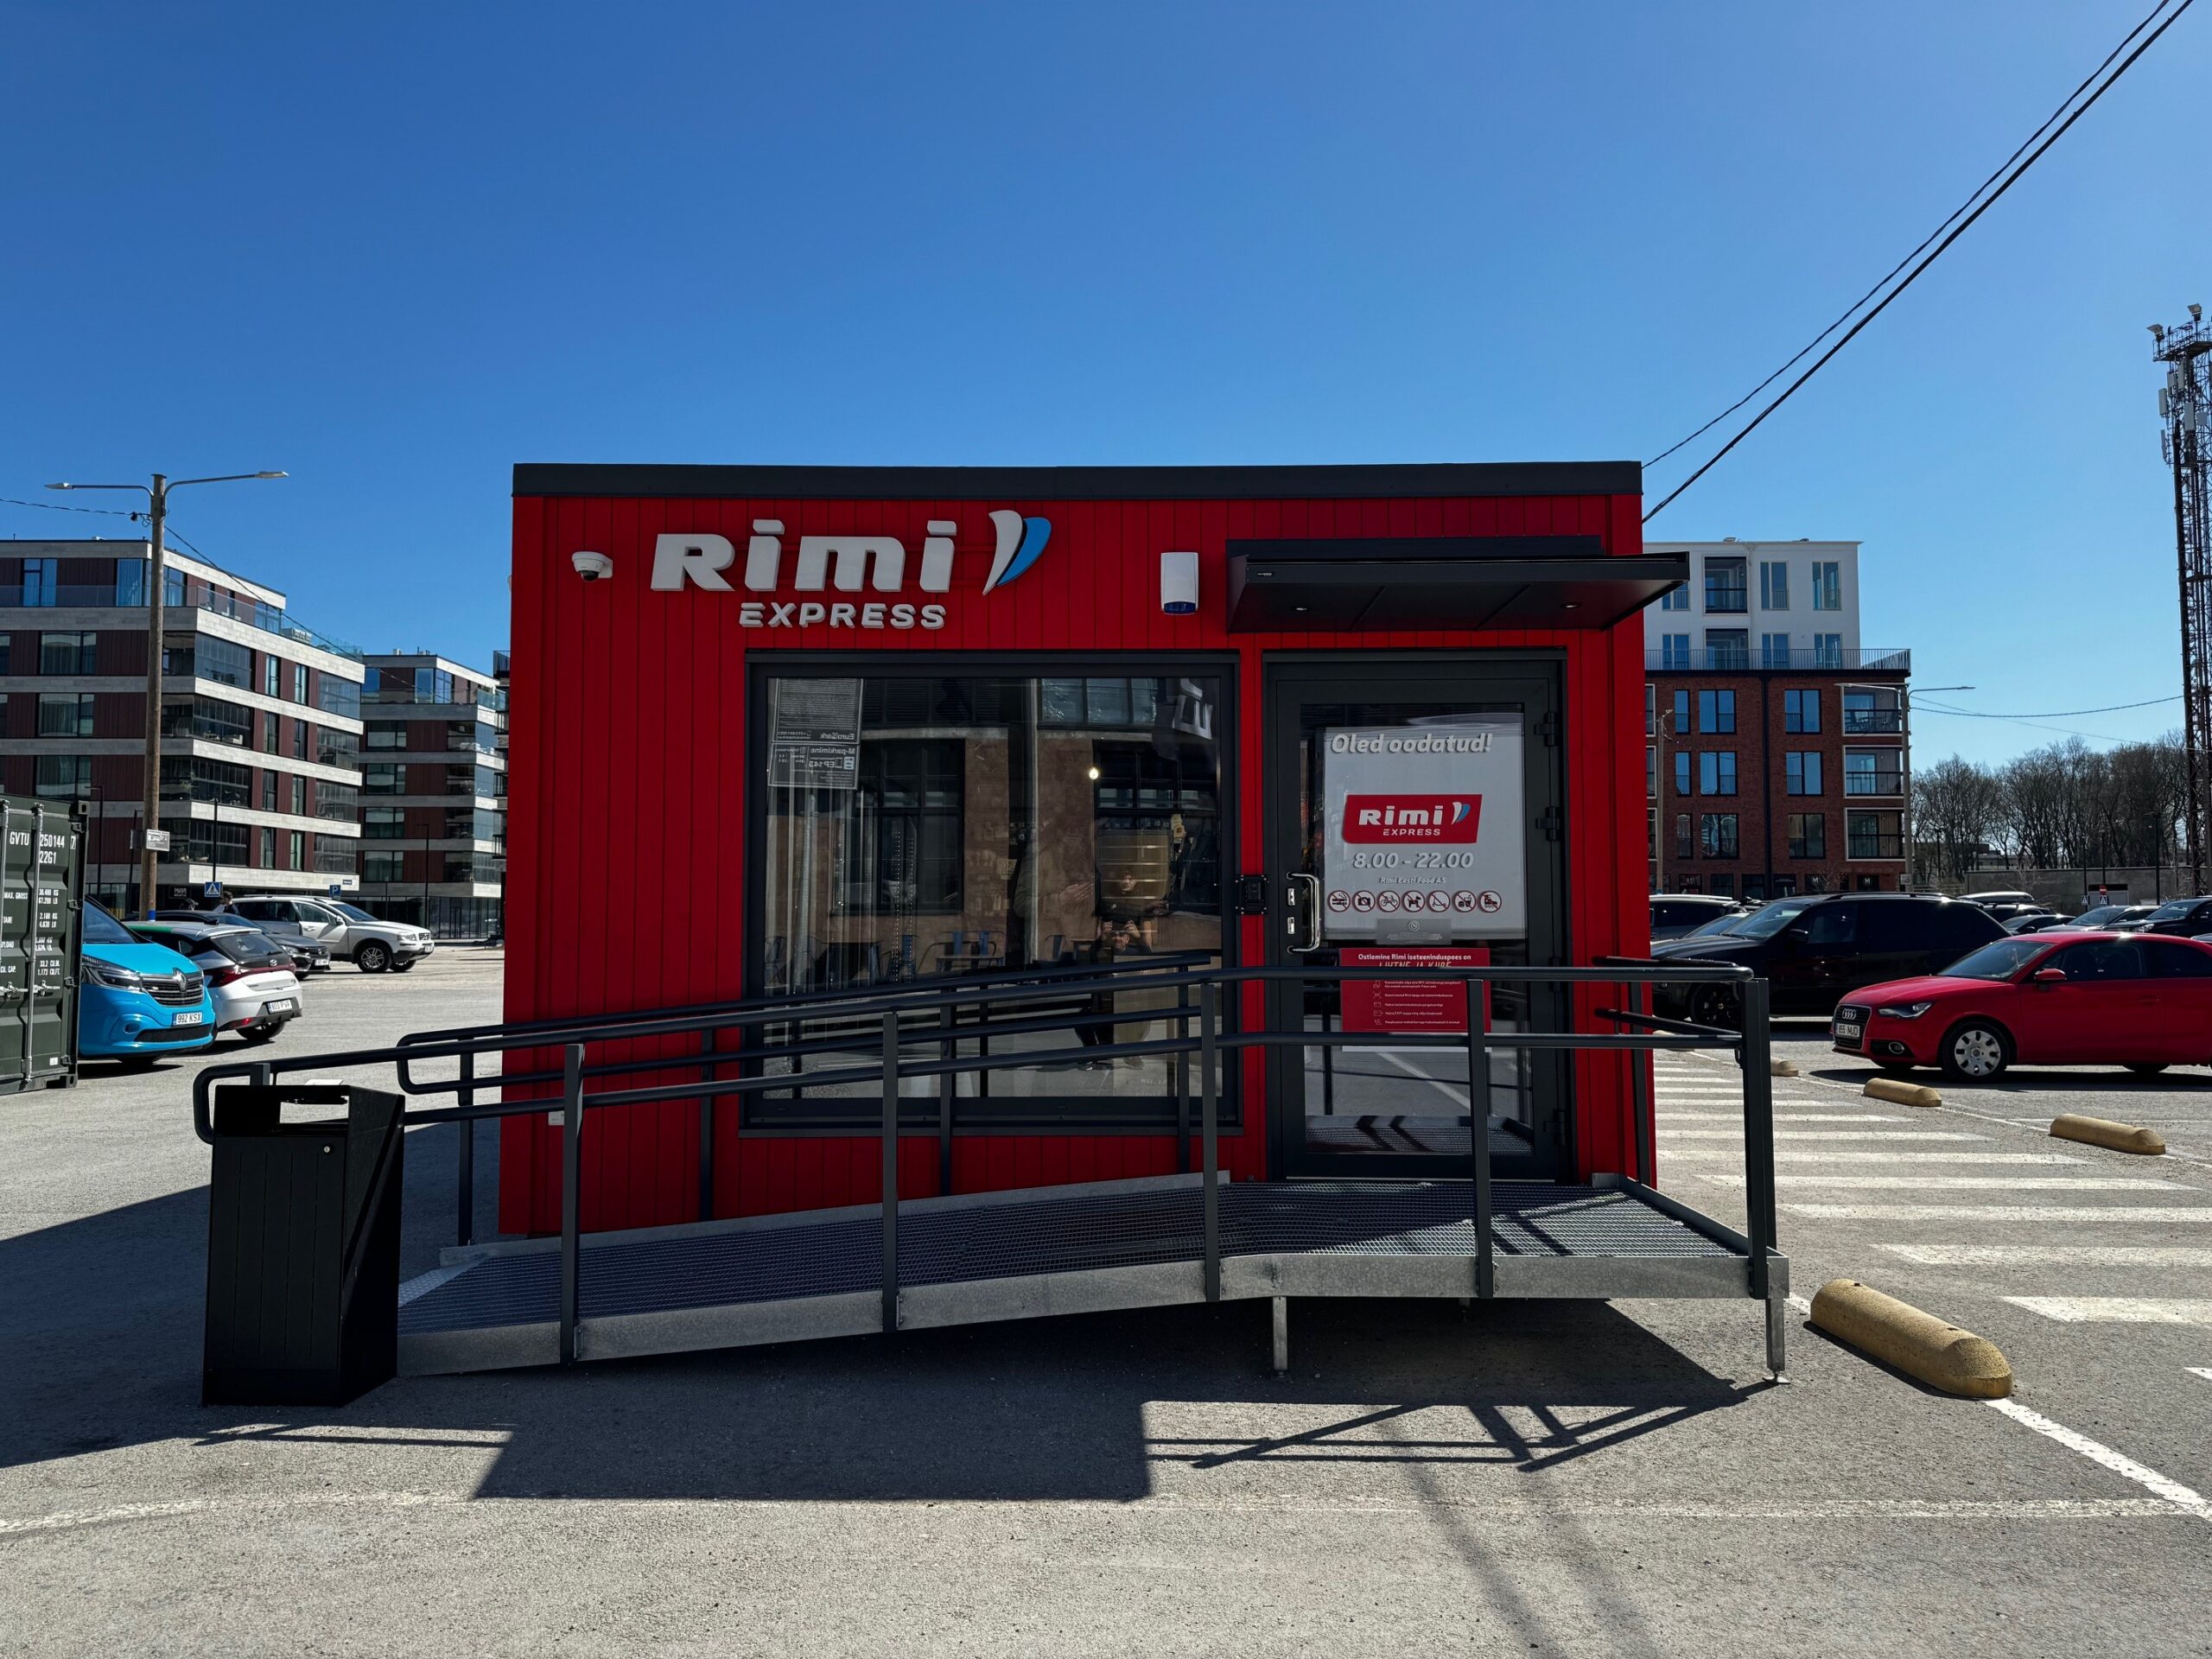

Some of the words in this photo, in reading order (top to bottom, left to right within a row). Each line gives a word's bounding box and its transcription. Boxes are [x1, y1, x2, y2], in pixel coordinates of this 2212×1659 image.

[651, 519, 957, 593] Rimi
[739, 602, 946, 630] EXPRESS
[1332, 734, 1384, 753] Oled
[1389, 733, 1493, 753] oodatud!
[1358, 805, 1444, 825] Rimi
[10, 831, 30, 846] GVTU
[40, 834, 66, 848] 250144
[71, 836, 76, 849] 7
[39, 851, 57, 864] 22G1
[1353, 852, 1399, 868] 8.00
[1415, 852, 1474, 868] 22.00
[332, 886, 339, 894] P
[1408, 953, 1462, 962] iseteeninduspoes
